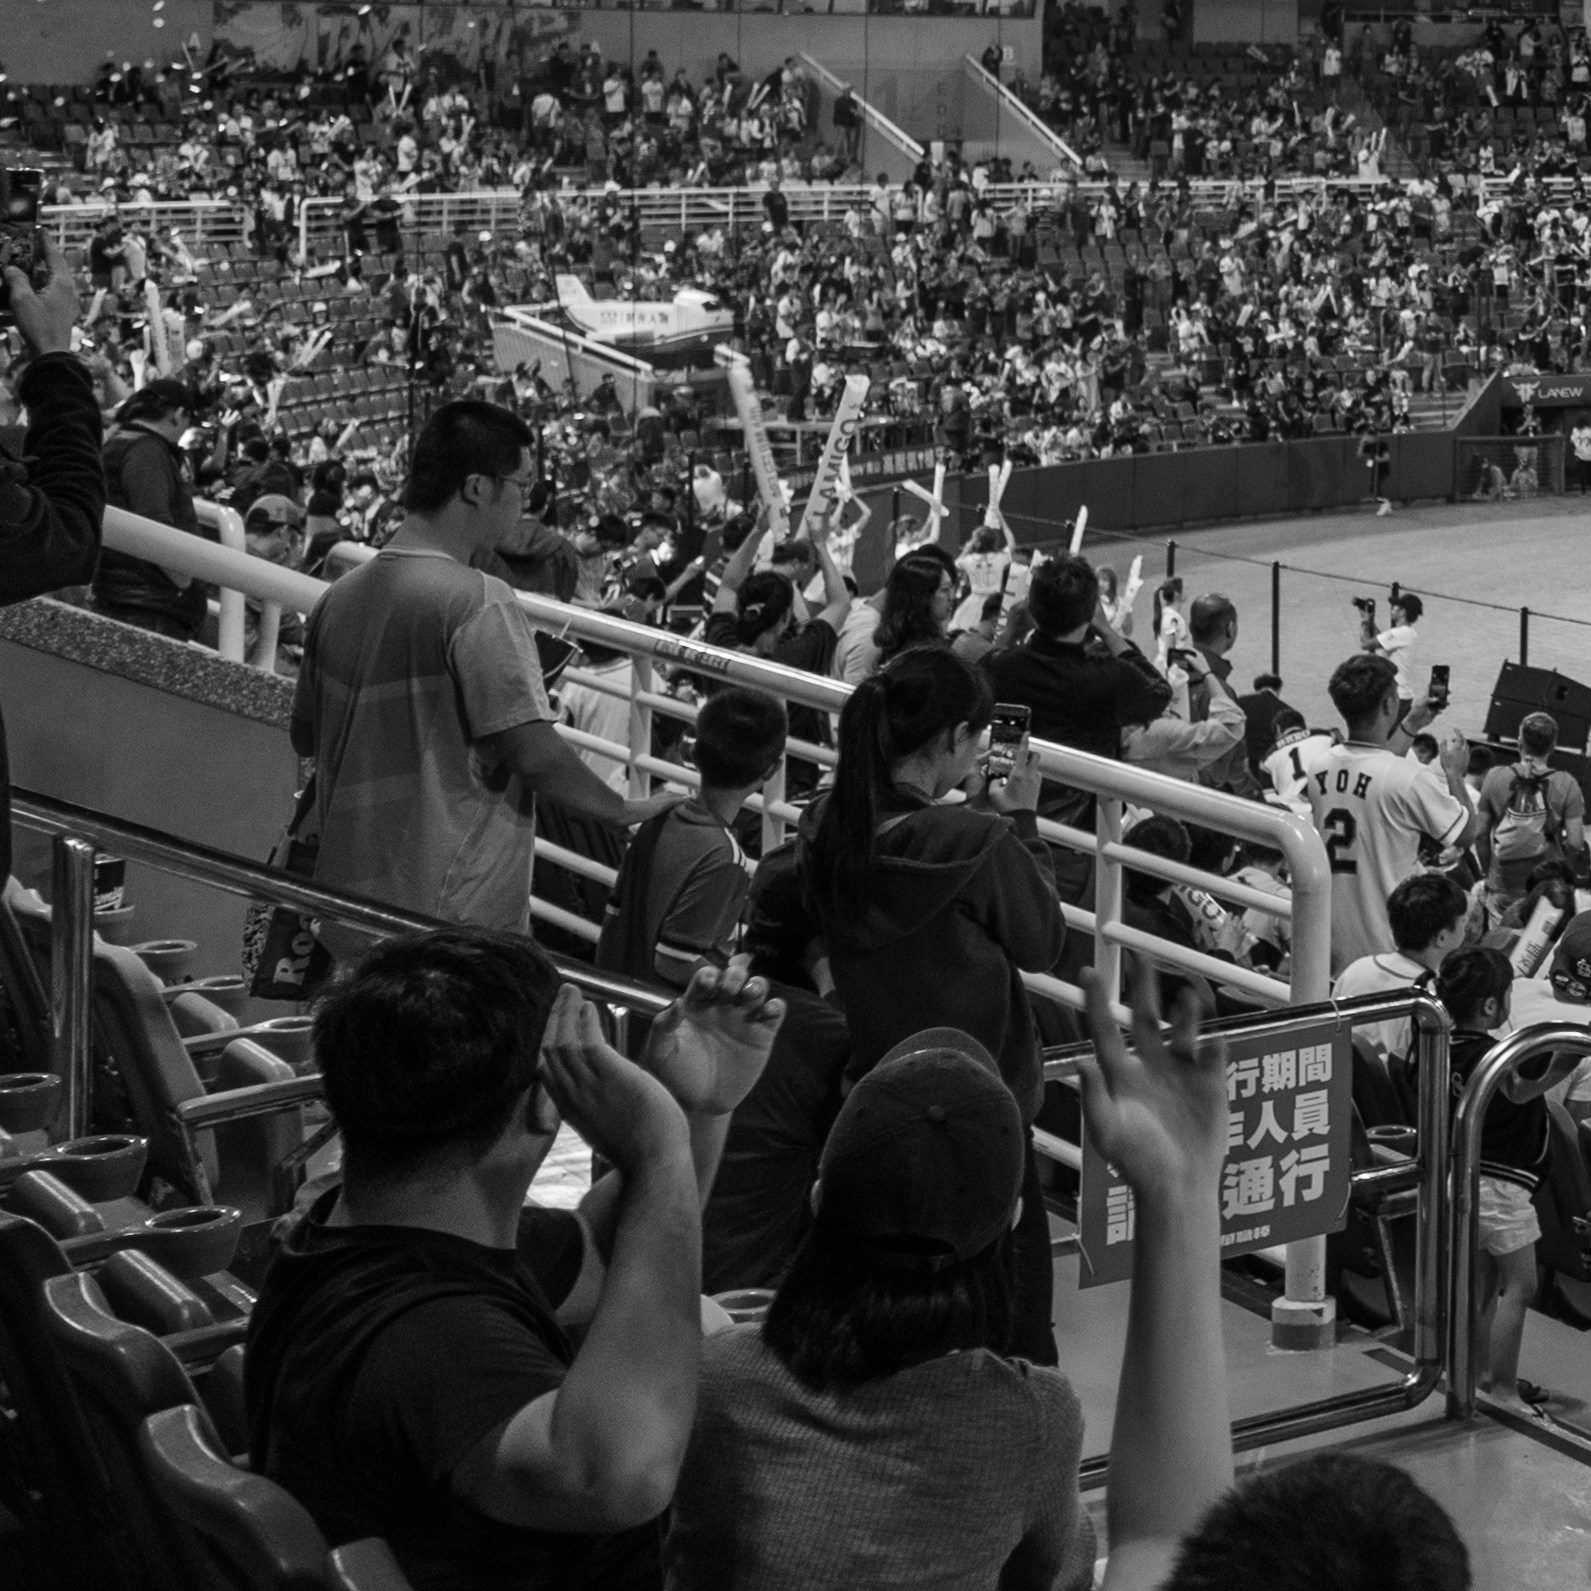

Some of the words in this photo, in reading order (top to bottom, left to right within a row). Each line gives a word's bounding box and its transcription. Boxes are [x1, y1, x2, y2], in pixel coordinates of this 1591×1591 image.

[1537, 386, 1584, 399] LANEW
[1289, 746, 1308, 781] 1
[1314, 768, 1373, 801] YOH
[1323, 807, 1358, 875] 2
